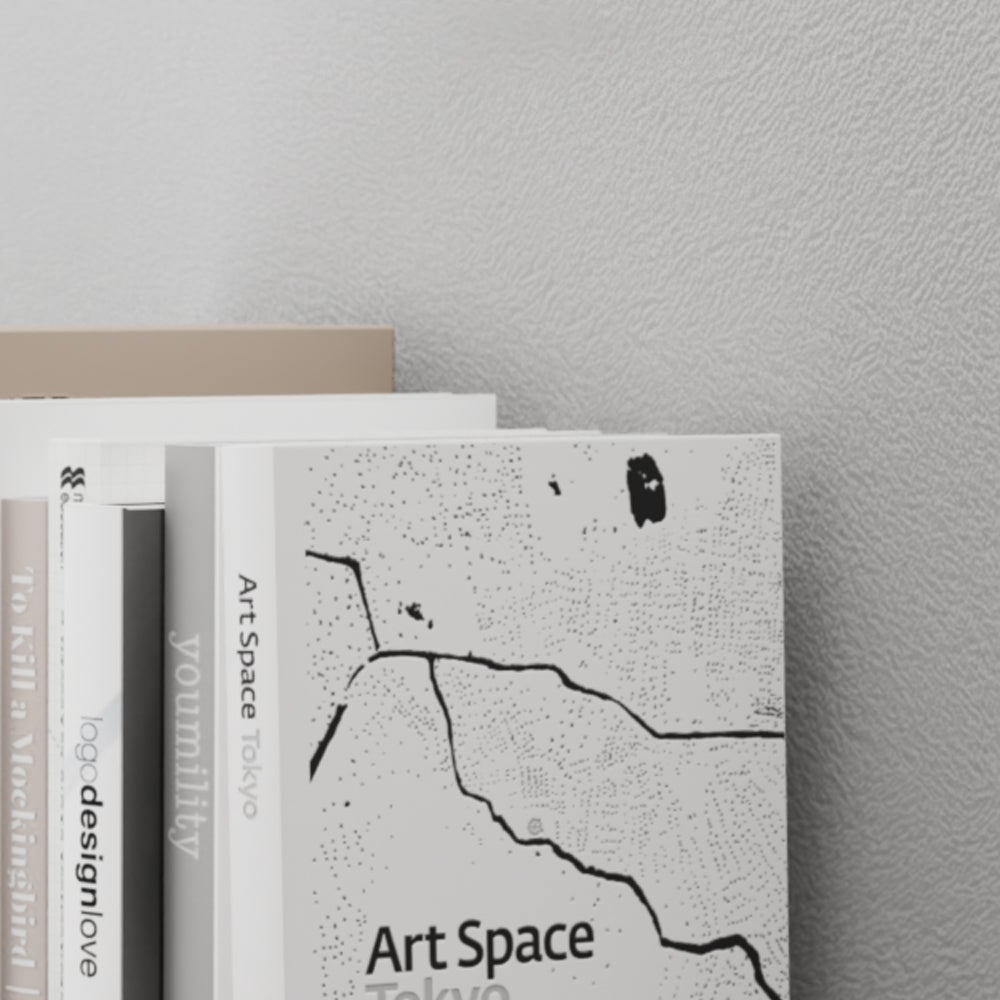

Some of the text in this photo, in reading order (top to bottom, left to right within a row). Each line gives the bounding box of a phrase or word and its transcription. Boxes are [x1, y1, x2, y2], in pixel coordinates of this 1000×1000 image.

[9, 566, 34, 614] To
[9, 624, 36, 691] Kill
[9, 699, 28, 720] a
[236, 574, 263, 820] Art Space Tokyo
[168, 630, 210, 860] youmility
[7, 729, 36, 969] Mockingbird
[365, 918, 595, 980] Art Space
